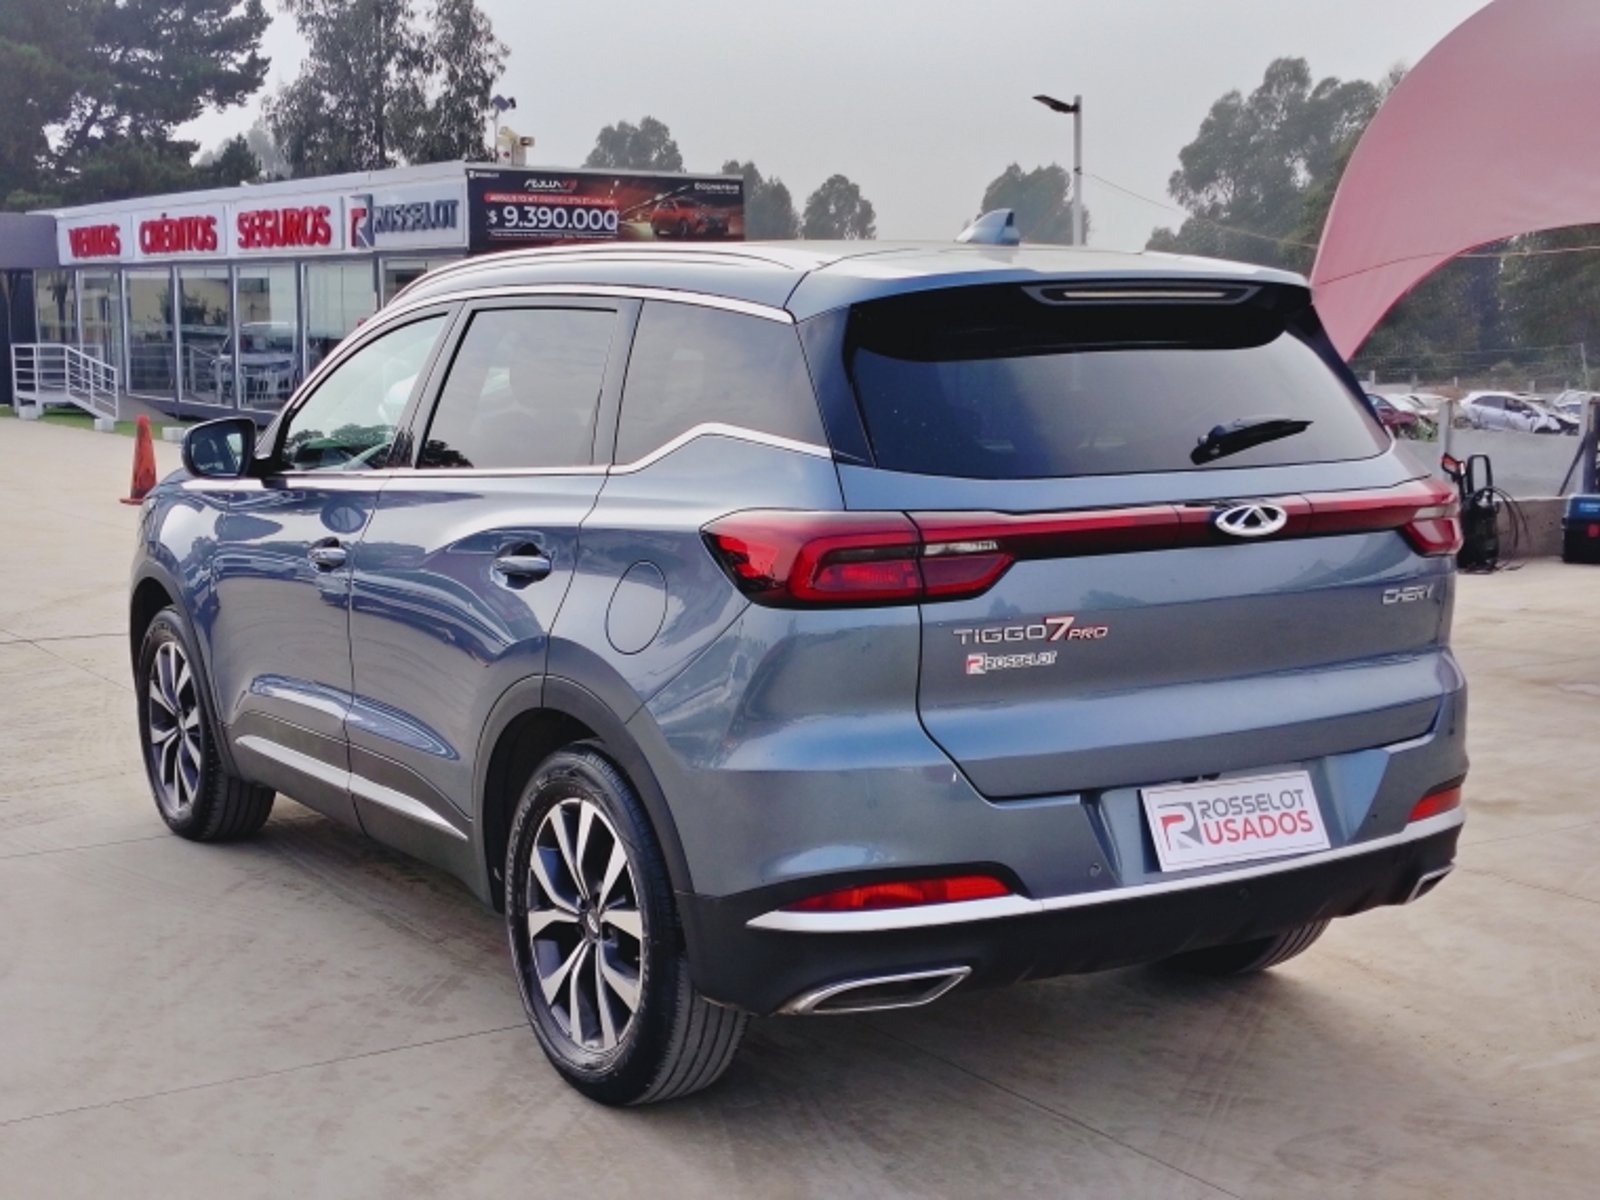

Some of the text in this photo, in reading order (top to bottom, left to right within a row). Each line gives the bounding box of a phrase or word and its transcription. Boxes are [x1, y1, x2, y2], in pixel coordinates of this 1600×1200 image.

[138, 212, 218, 255] CRÉDITOS
[237, 204, 333, 250] SEGUROS
[374, 200, 459, 234] ROSSELOT
[502, 205, 619, 231] 9.390.000
[68, 223, 121, 259] VENTAS
[953, 614, 1109, 645] TIGGO 7 PRO
[1197, 789, 1304, 820] ROSSELOT
[1203, 810, 1314, 845] USADOS
